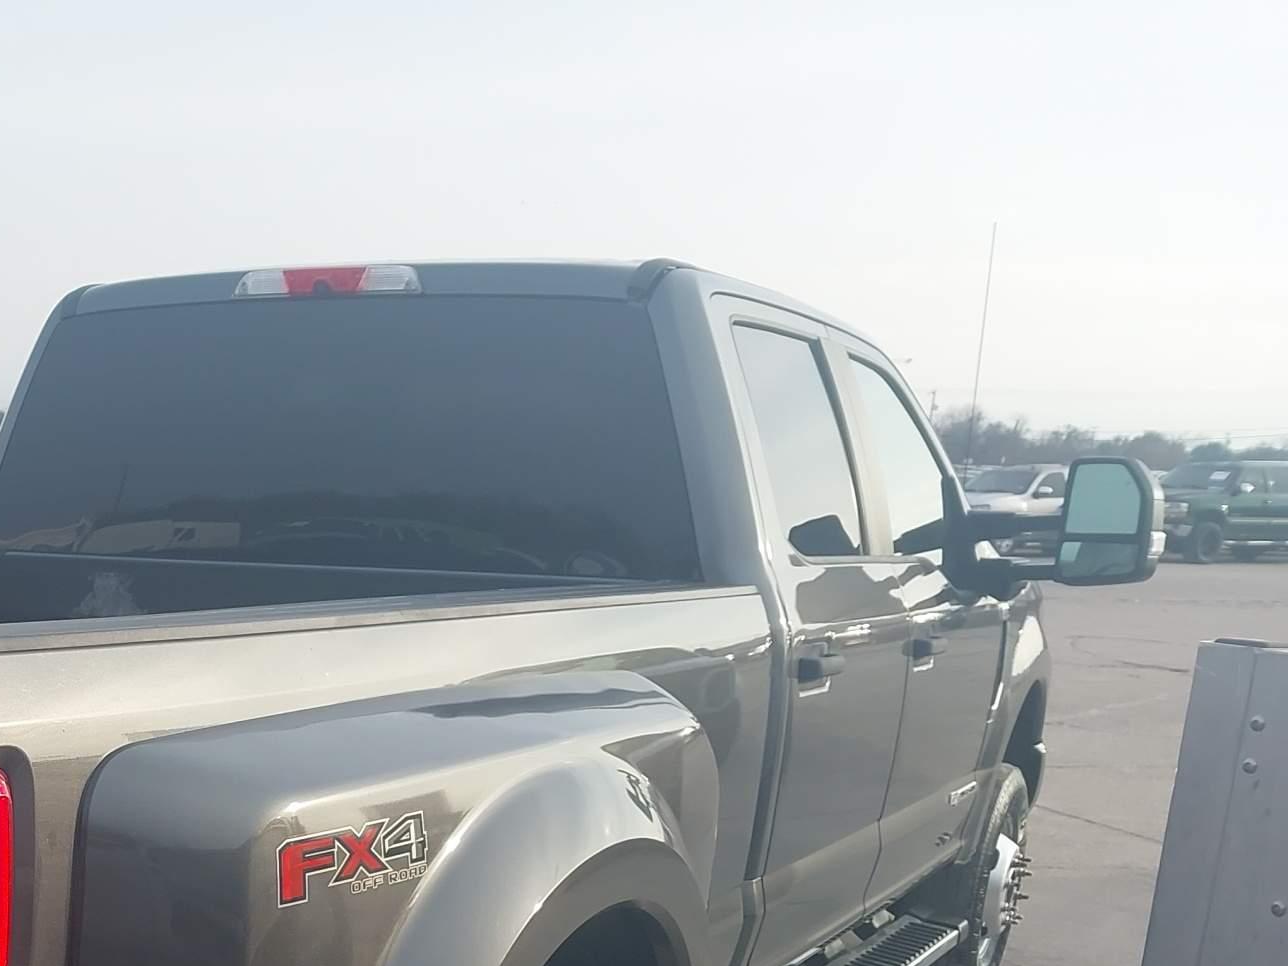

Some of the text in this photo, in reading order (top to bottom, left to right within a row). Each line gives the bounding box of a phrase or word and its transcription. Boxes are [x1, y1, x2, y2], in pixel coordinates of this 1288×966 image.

[276, 810, 429, 908] FX4
[351, 863, 428, 894] OFF ROAD
